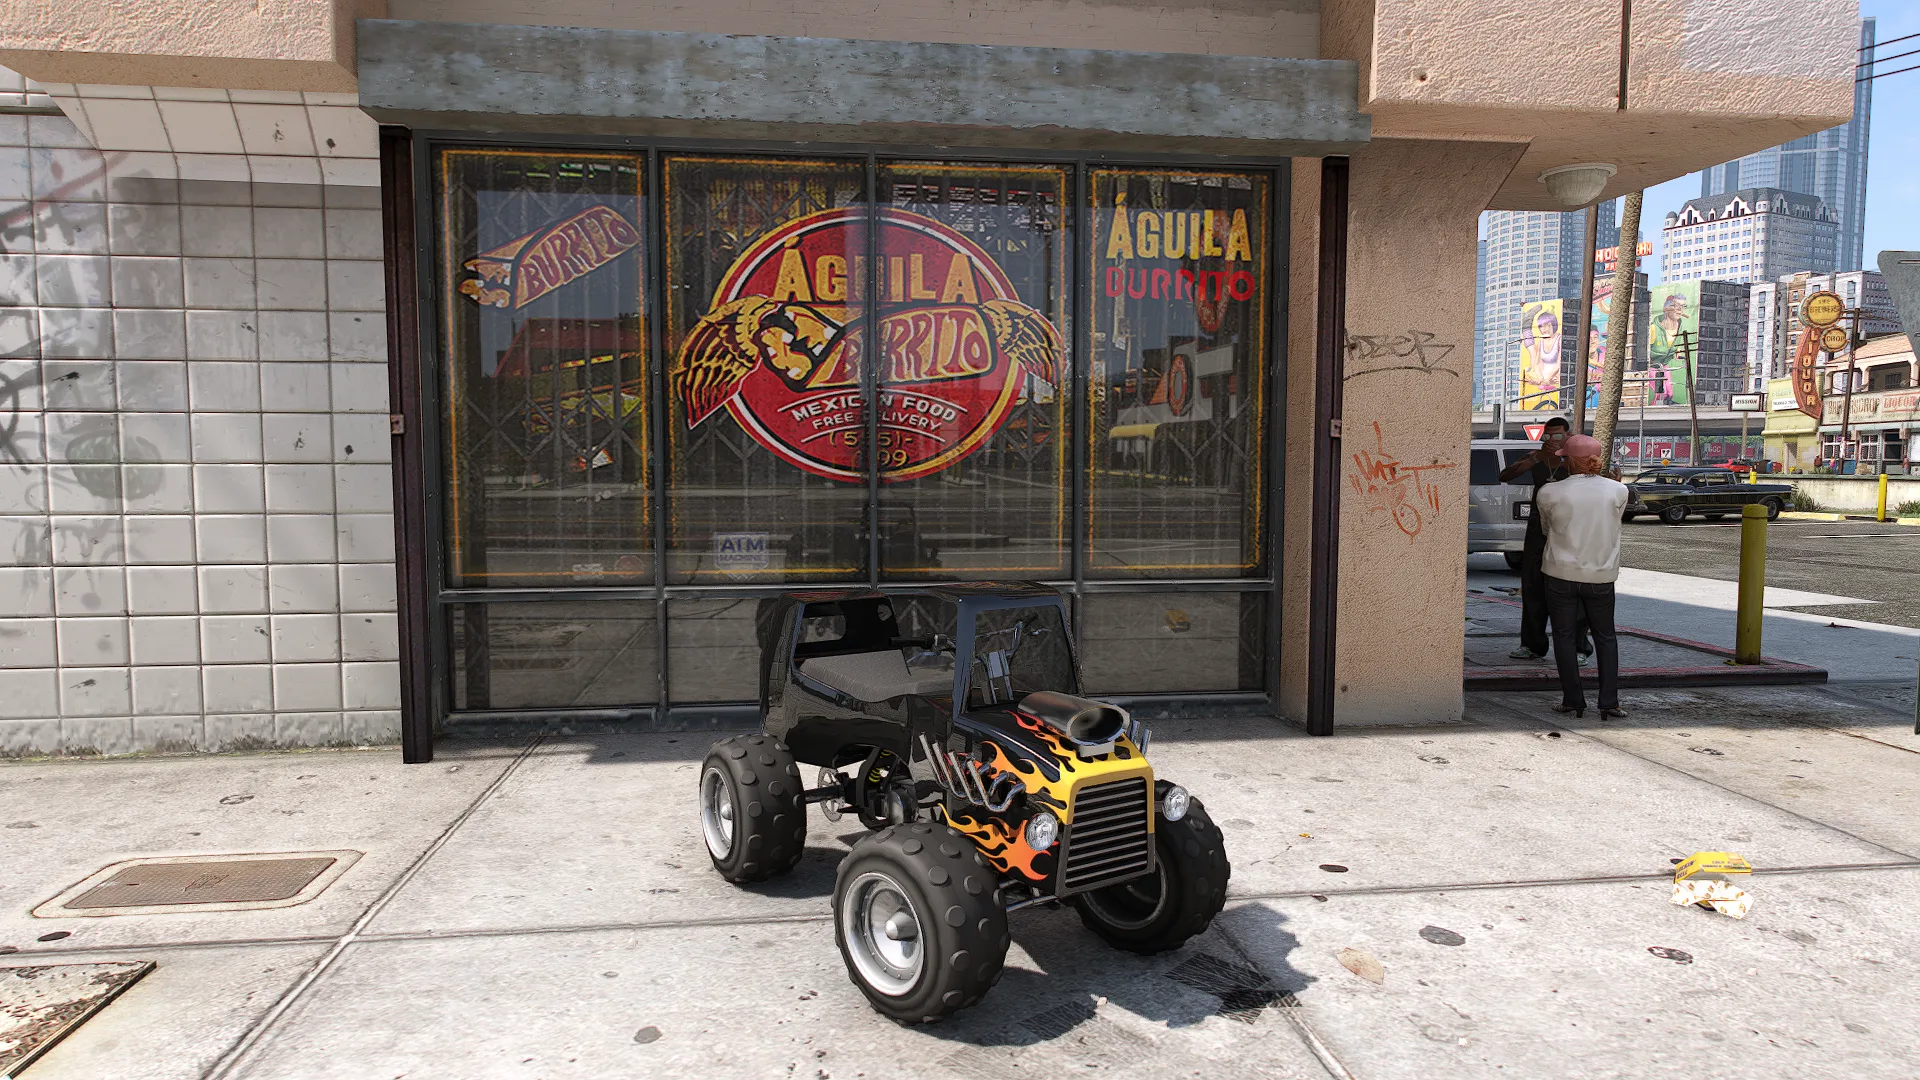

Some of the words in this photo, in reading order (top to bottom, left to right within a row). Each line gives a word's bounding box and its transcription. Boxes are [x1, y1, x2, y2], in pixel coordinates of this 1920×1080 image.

[1105, 191, 1252, 262] ÁGUILA
[522, 208, 640, 300] BURRITO
[1105, 266, 1256, 302] BURRITO
[812, 411, 855, 430] FREE
[902, 396, 957, 422] FOOD
[720, 536, 764, 553] ATM
